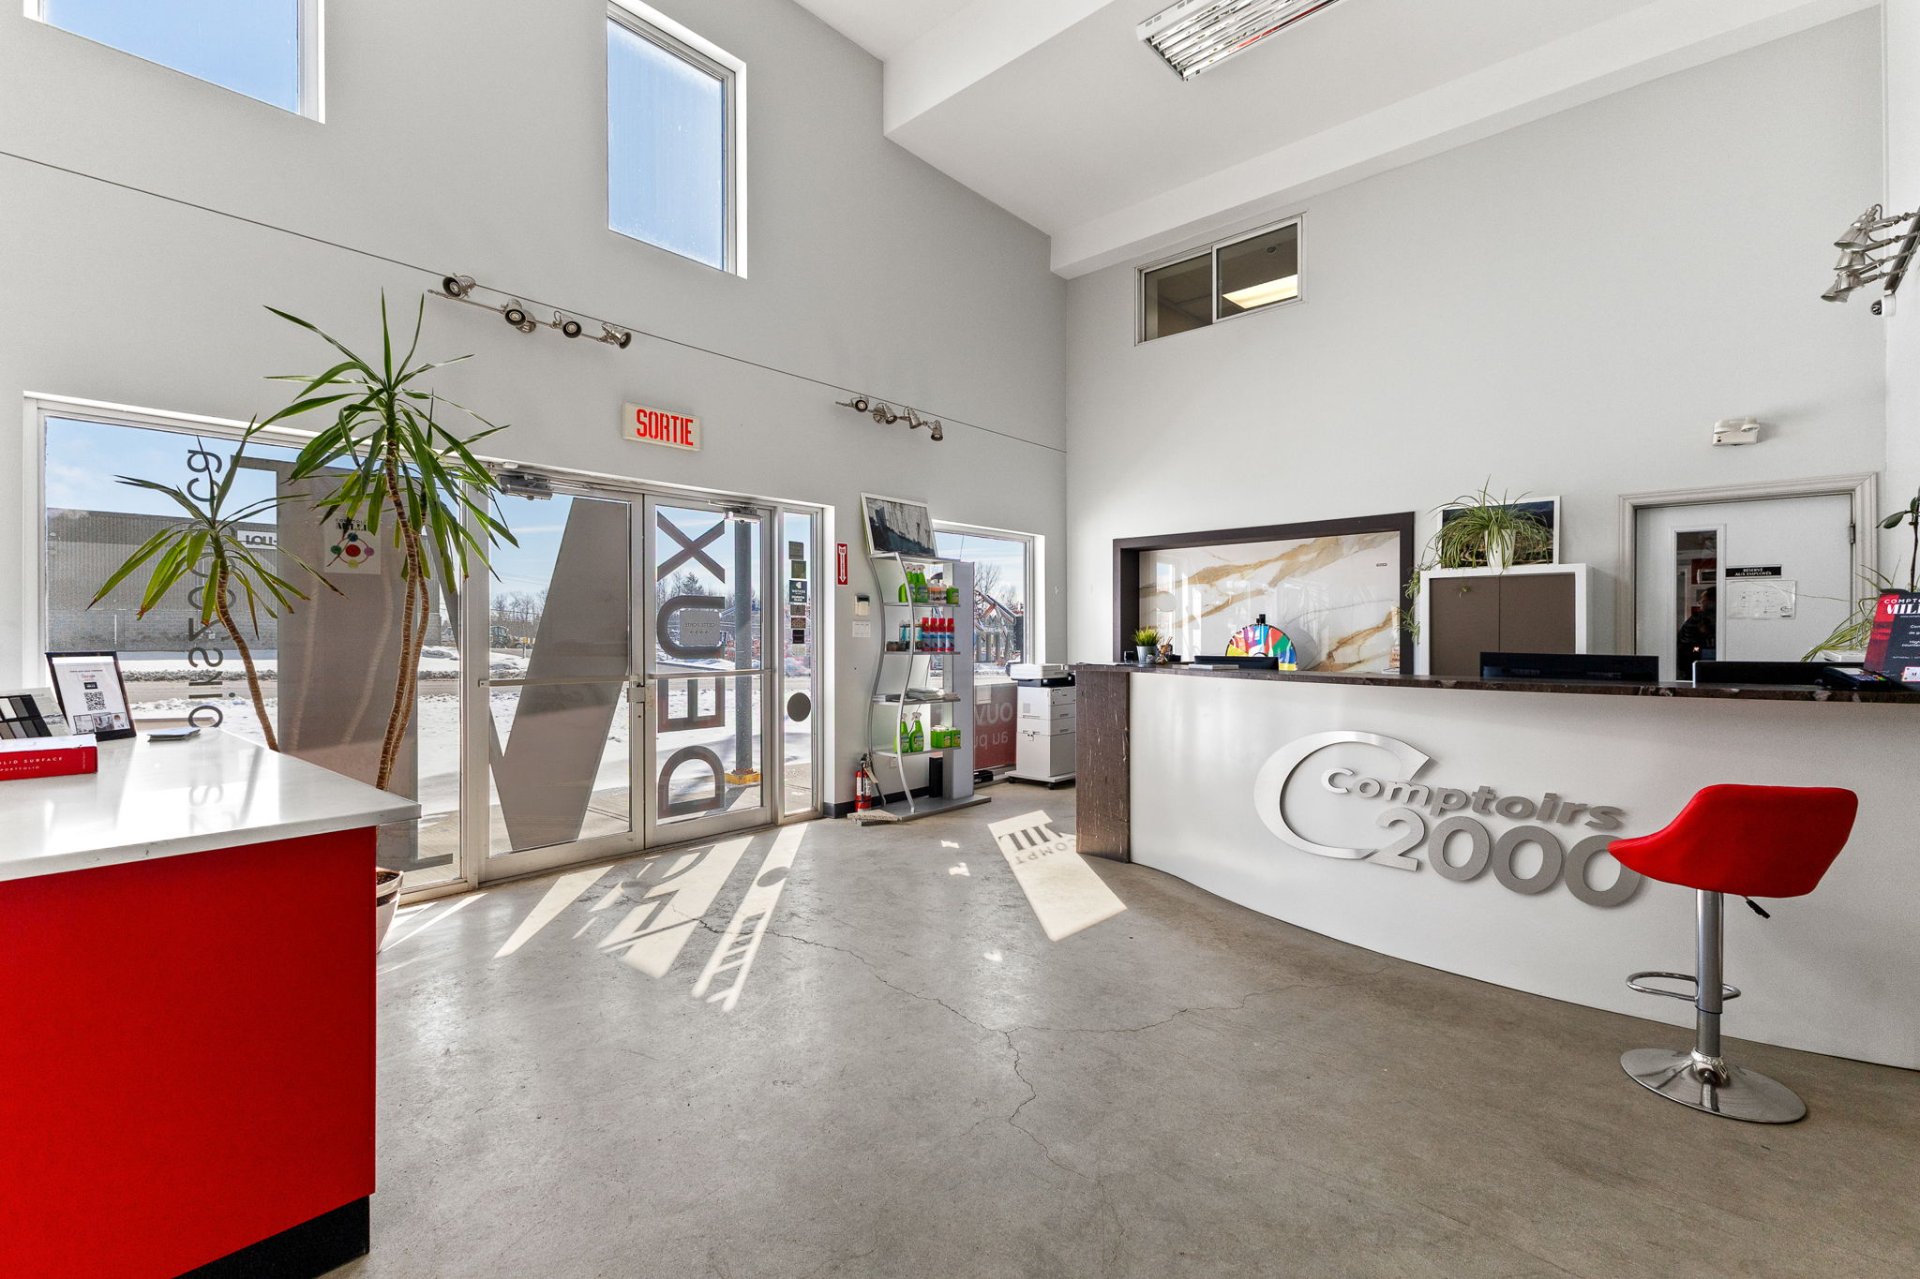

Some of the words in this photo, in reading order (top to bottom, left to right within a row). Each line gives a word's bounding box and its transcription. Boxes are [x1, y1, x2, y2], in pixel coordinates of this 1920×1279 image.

[636, 408, 694, 446] SORTIE
[23, 756, 63, 764] SURFACE
[1321, 767, 1626, 831] Comptoirs
[1364, 807, 1642, 908] 2000
